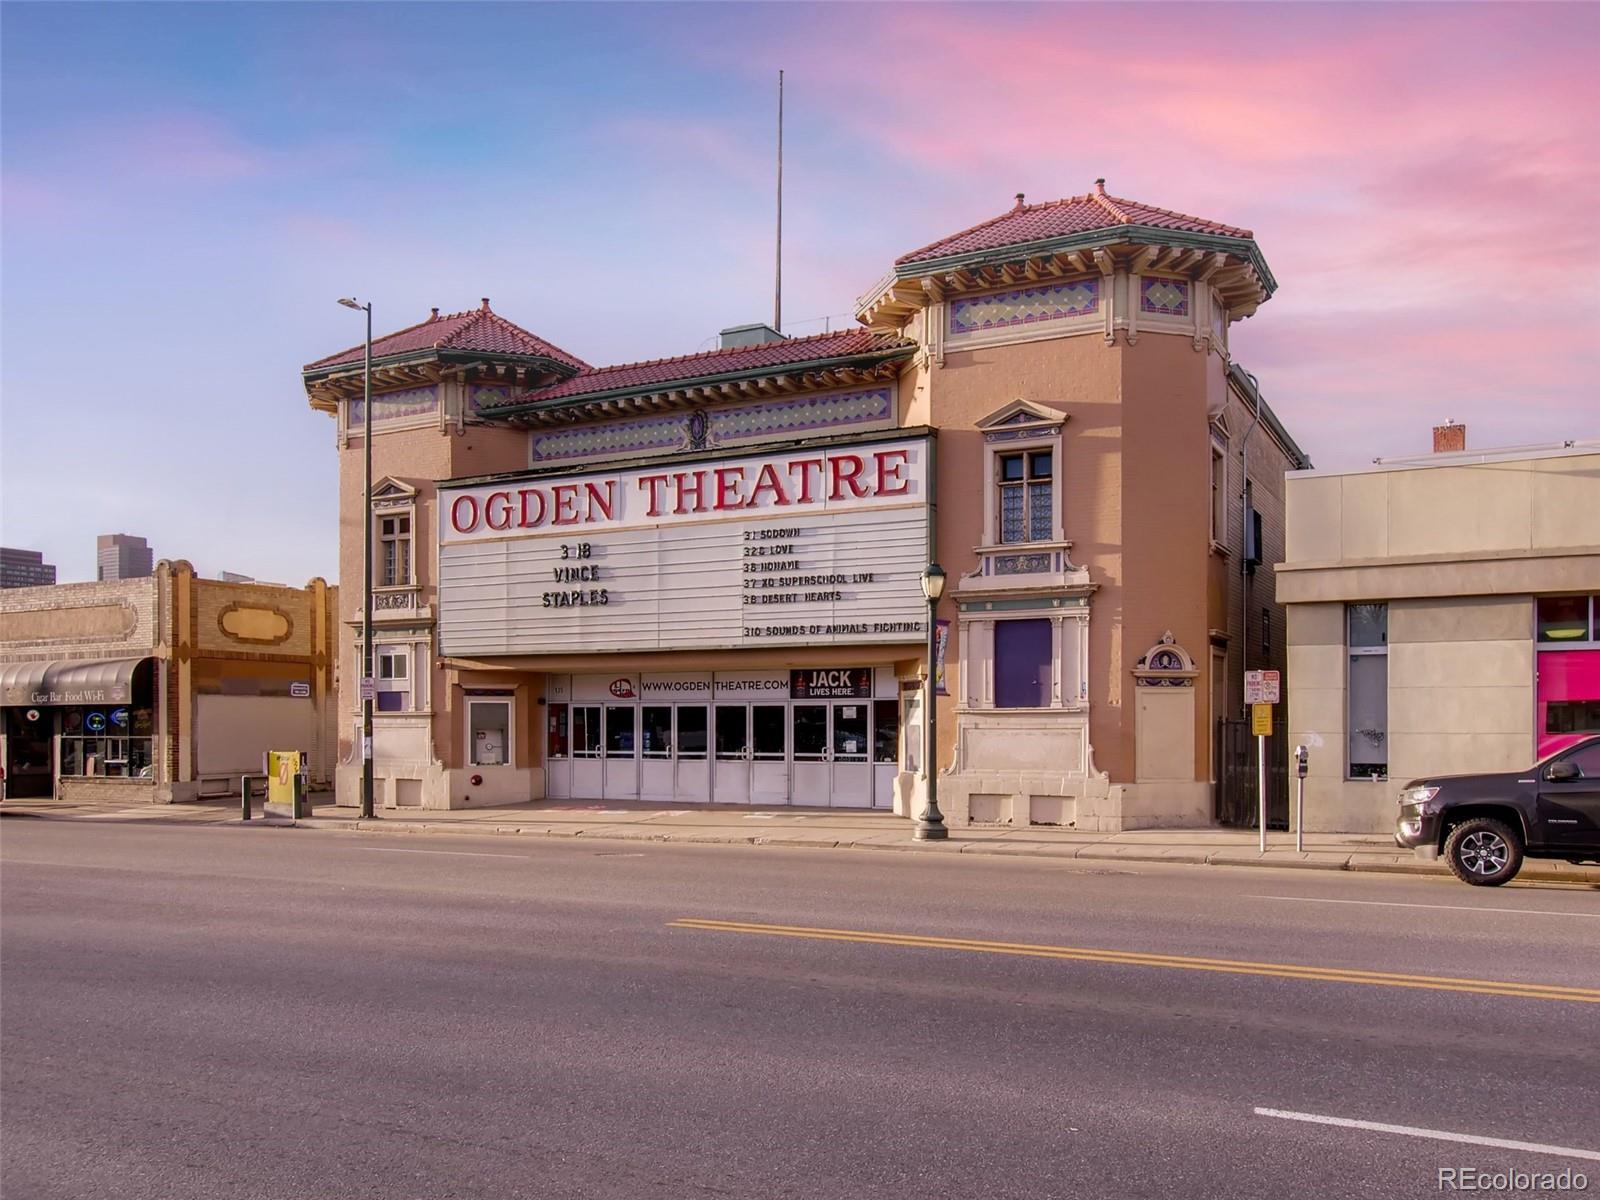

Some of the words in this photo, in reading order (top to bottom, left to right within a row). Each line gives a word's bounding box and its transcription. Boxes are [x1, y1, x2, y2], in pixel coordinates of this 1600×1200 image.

[451, 480, 616, 534] OGDEN
[638, 450, 909, 517] THEATRE
[770, 545, 794, 555] LOVE
[553, 565, 600, 583] VINCE
[779, 574, 848, 587] SUPERSCHOOL
[852, 573, 874, 584] LIVE
[542, 589, 609, 608] STAPLES
[762, 593, 798, 604] DESERT
[804, 591, 842, 602] HEARTS
[766, 625, 805, 637] SOUNDS
[809, 624, 821, 635] OF
[826, 623, 868, 634] ANIMALS
[873, 621, 921, 633] FIGHTING
[809, 670, 852, 687] JACK
[31, 691, 48, 703] Cigar
[49, 691, 62, 702] Bar
[65, 690, 82, 702] Food
[84, 690, 105, 701] Wi-Fi
[809, 688, 830, 696] LIVES
